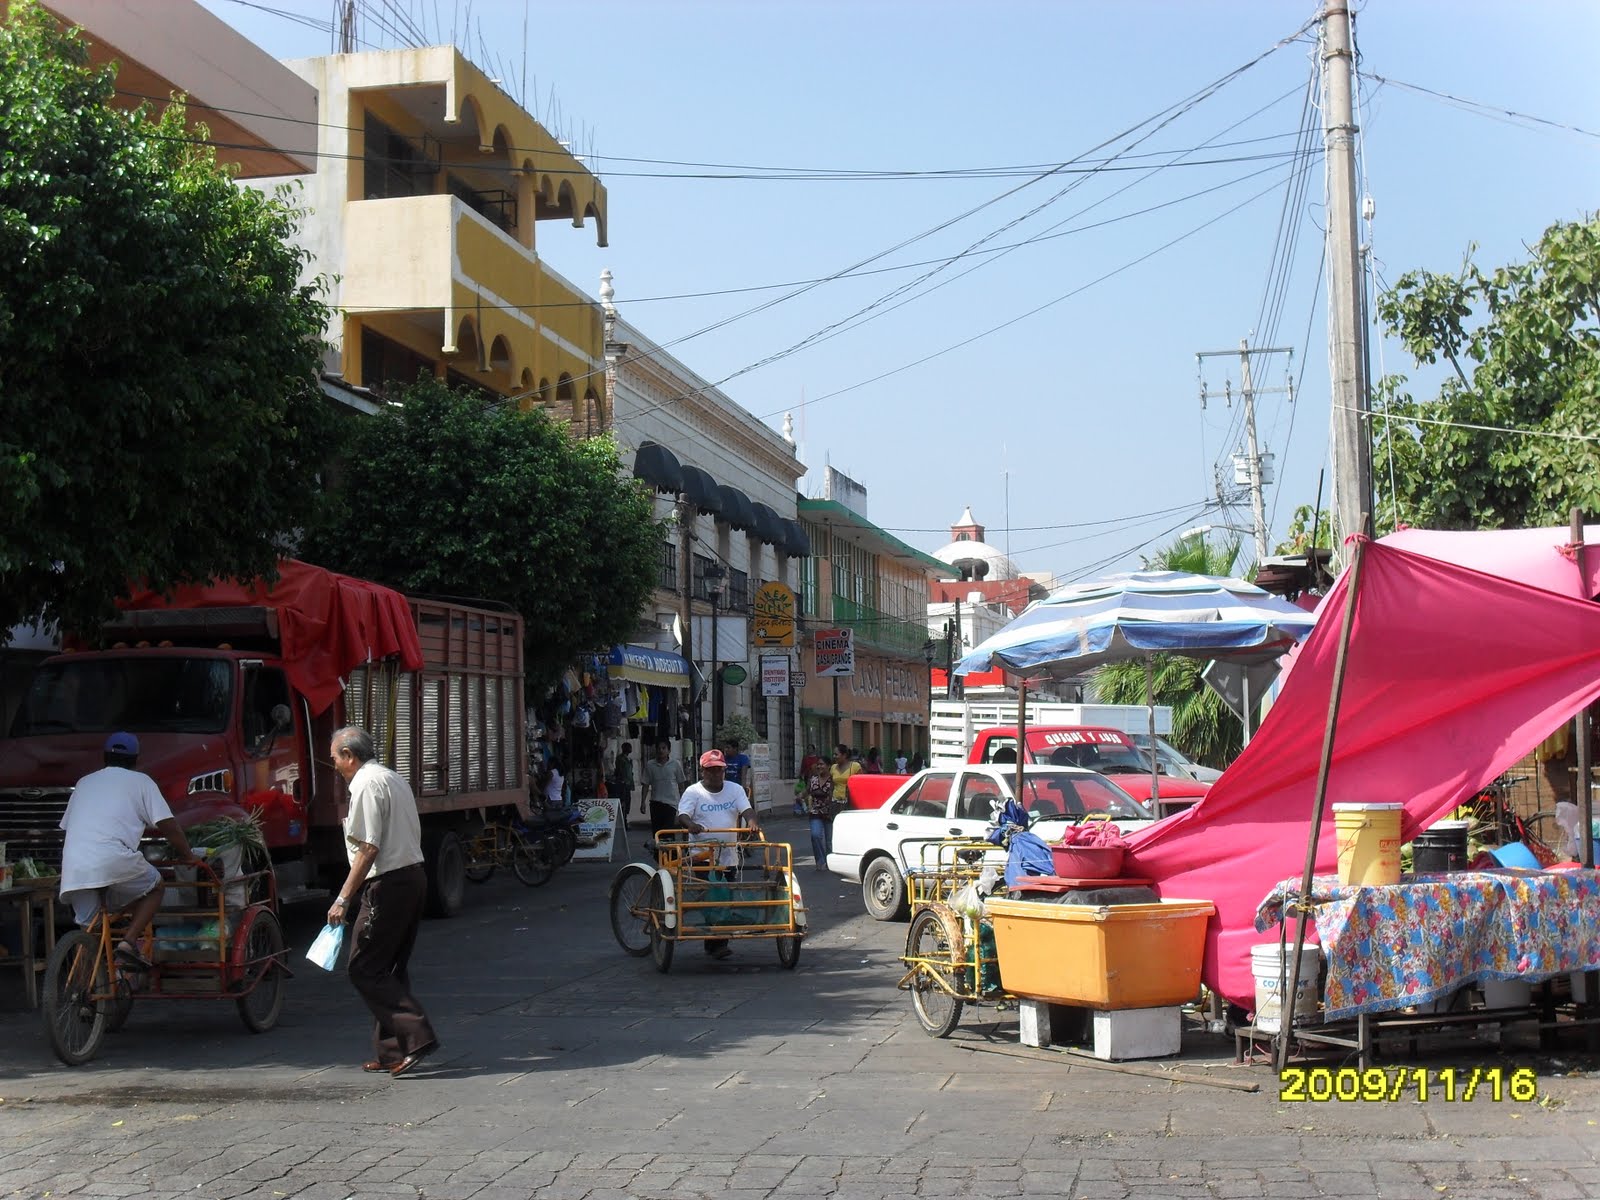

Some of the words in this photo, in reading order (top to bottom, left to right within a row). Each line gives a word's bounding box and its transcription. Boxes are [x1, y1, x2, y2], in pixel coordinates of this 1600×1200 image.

[756, 590, 792, 610] CINEMA
[816, 640, 850, 650] CINEMA
[816, 653, 830, 665] CASA
[831, 652, 852, 665] GRANDE
[850, 664, 881, 697] CASA
[1044, 732, 1087, 745] QUIQUE
[1087, 731, 1096, 742] Y
[1098, 732, 1122, 744] LUIS
[700, 800, 737, 812] Comex
